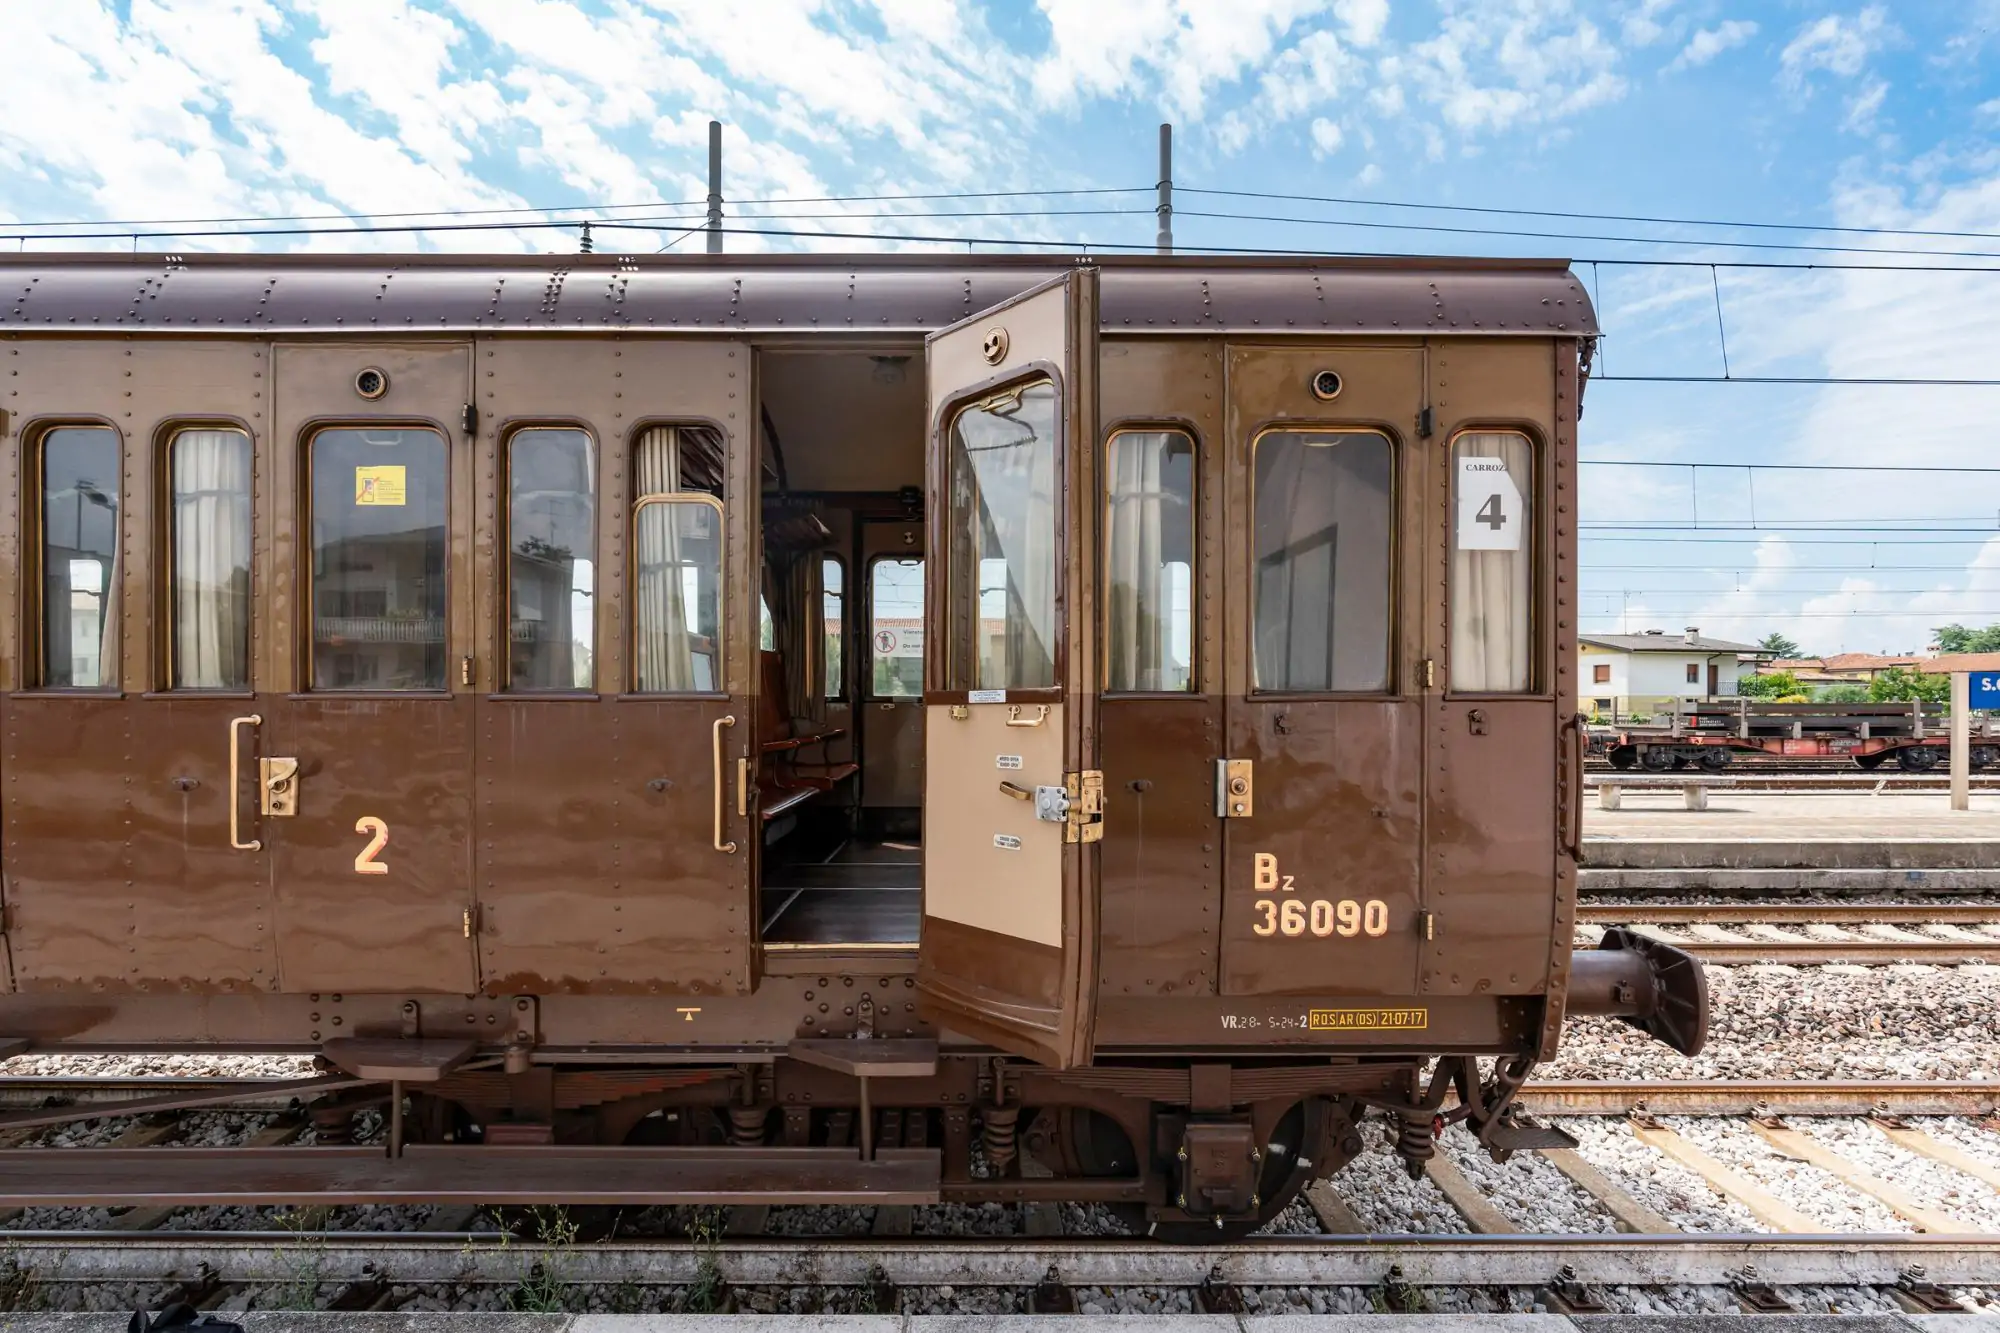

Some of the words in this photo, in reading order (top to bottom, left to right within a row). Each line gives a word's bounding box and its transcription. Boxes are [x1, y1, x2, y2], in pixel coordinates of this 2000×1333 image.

[1465, 464, 1508, 472] CARROZ
[1475, 494, 1507, 531] 4
[354, 816, 389, 875] 2
[1253, 899, 1388, 937] 36090
